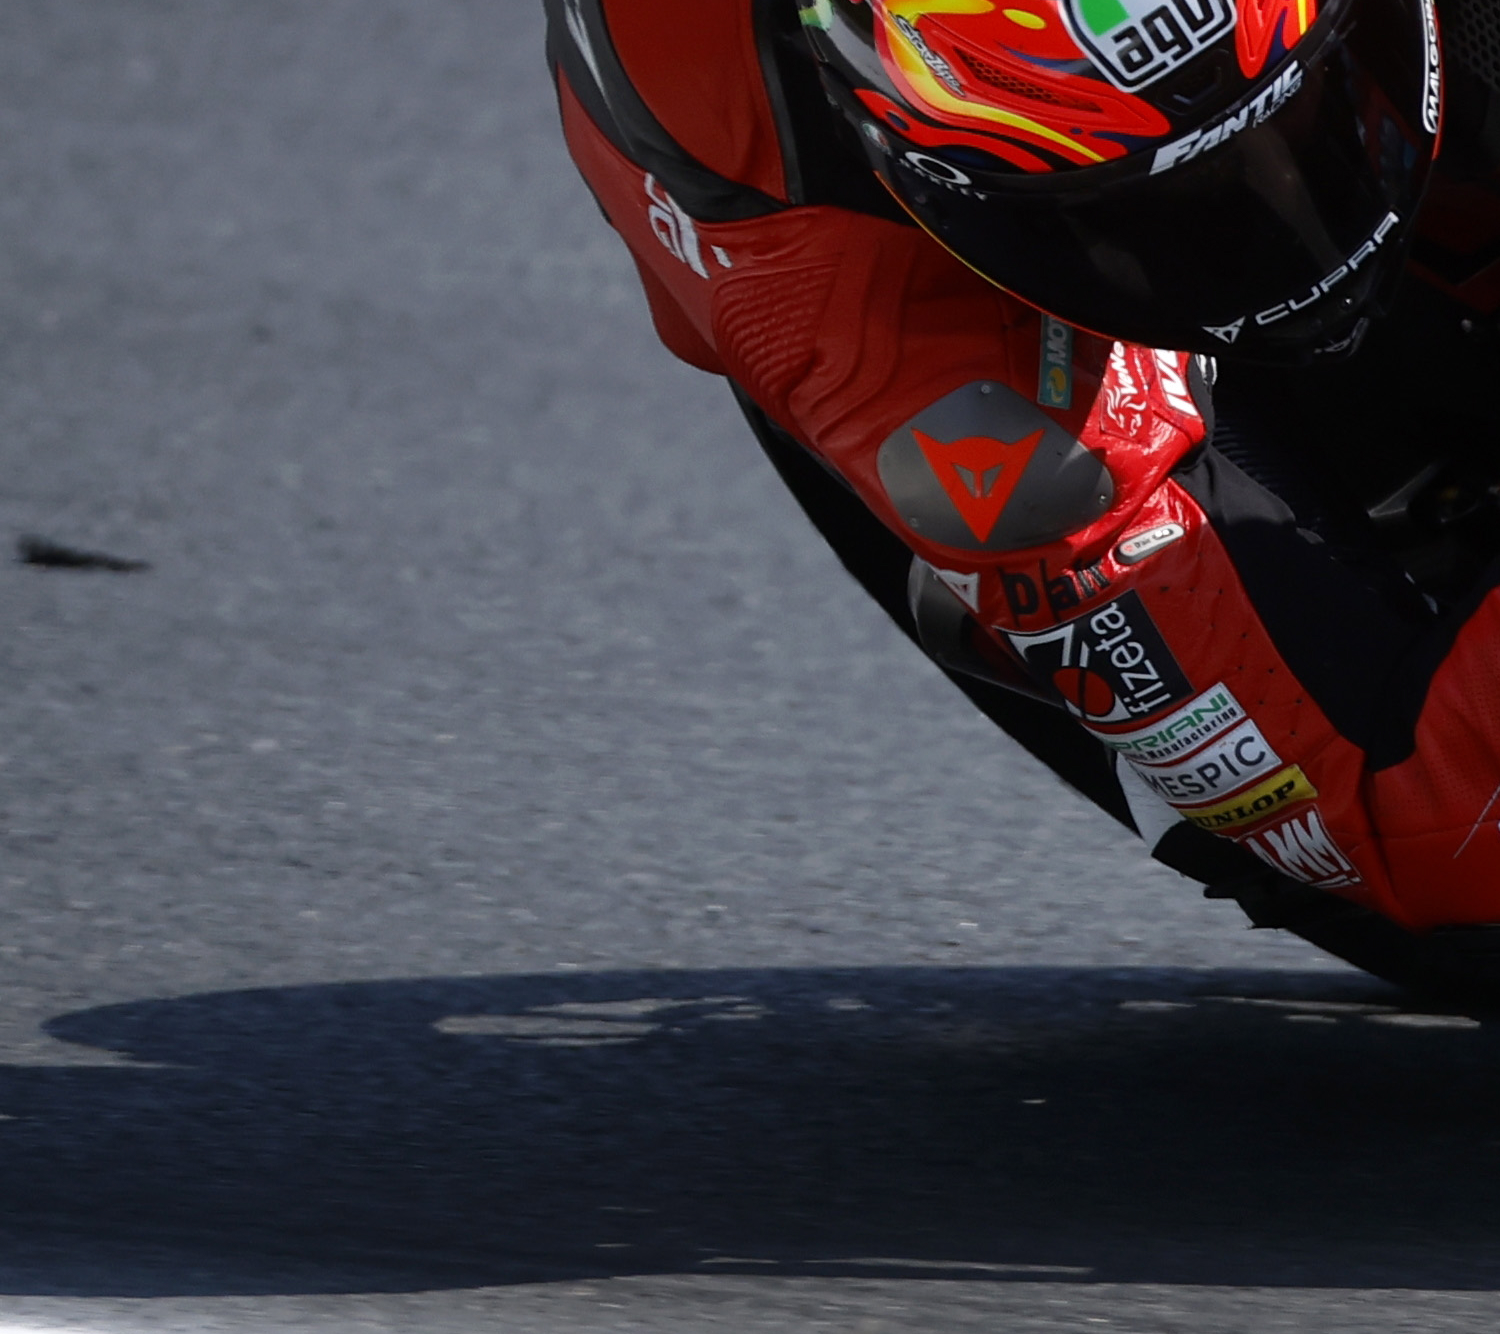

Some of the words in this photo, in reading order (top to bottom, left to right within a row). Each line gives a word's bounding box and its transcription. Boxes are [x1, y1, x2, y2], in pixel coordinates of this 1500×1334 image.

[1149, 59, 1303, 177] FANTIC
[1254, 210, 1400, 326] CUPRA
[1089, 601, 1173, 715] fizeta
